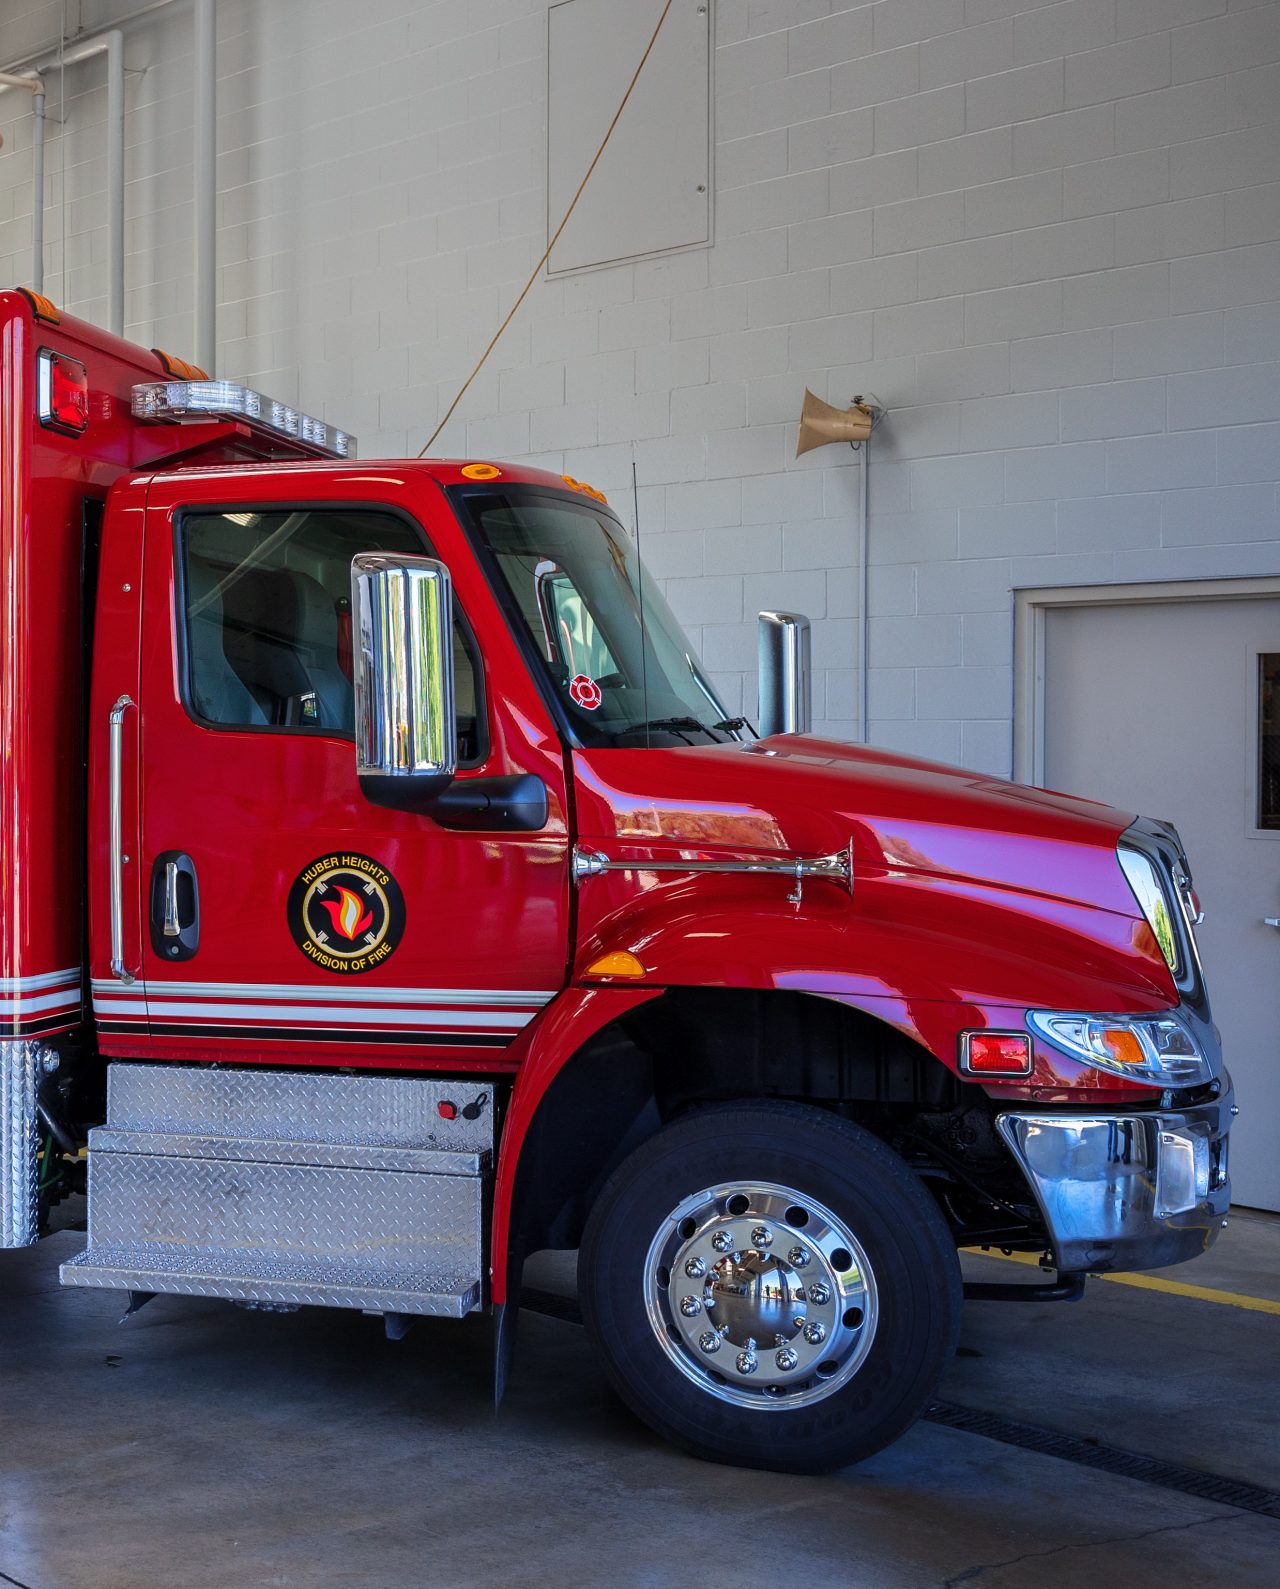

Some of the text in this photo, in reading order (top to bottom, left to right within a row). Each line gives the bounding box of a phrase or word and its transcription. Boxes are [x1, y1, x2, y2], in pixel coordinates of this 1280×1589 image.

[301, 856, 390, 886] HUBER HEIGHTS
[302, 940, 392, 971] DIVISION OF FIRE
